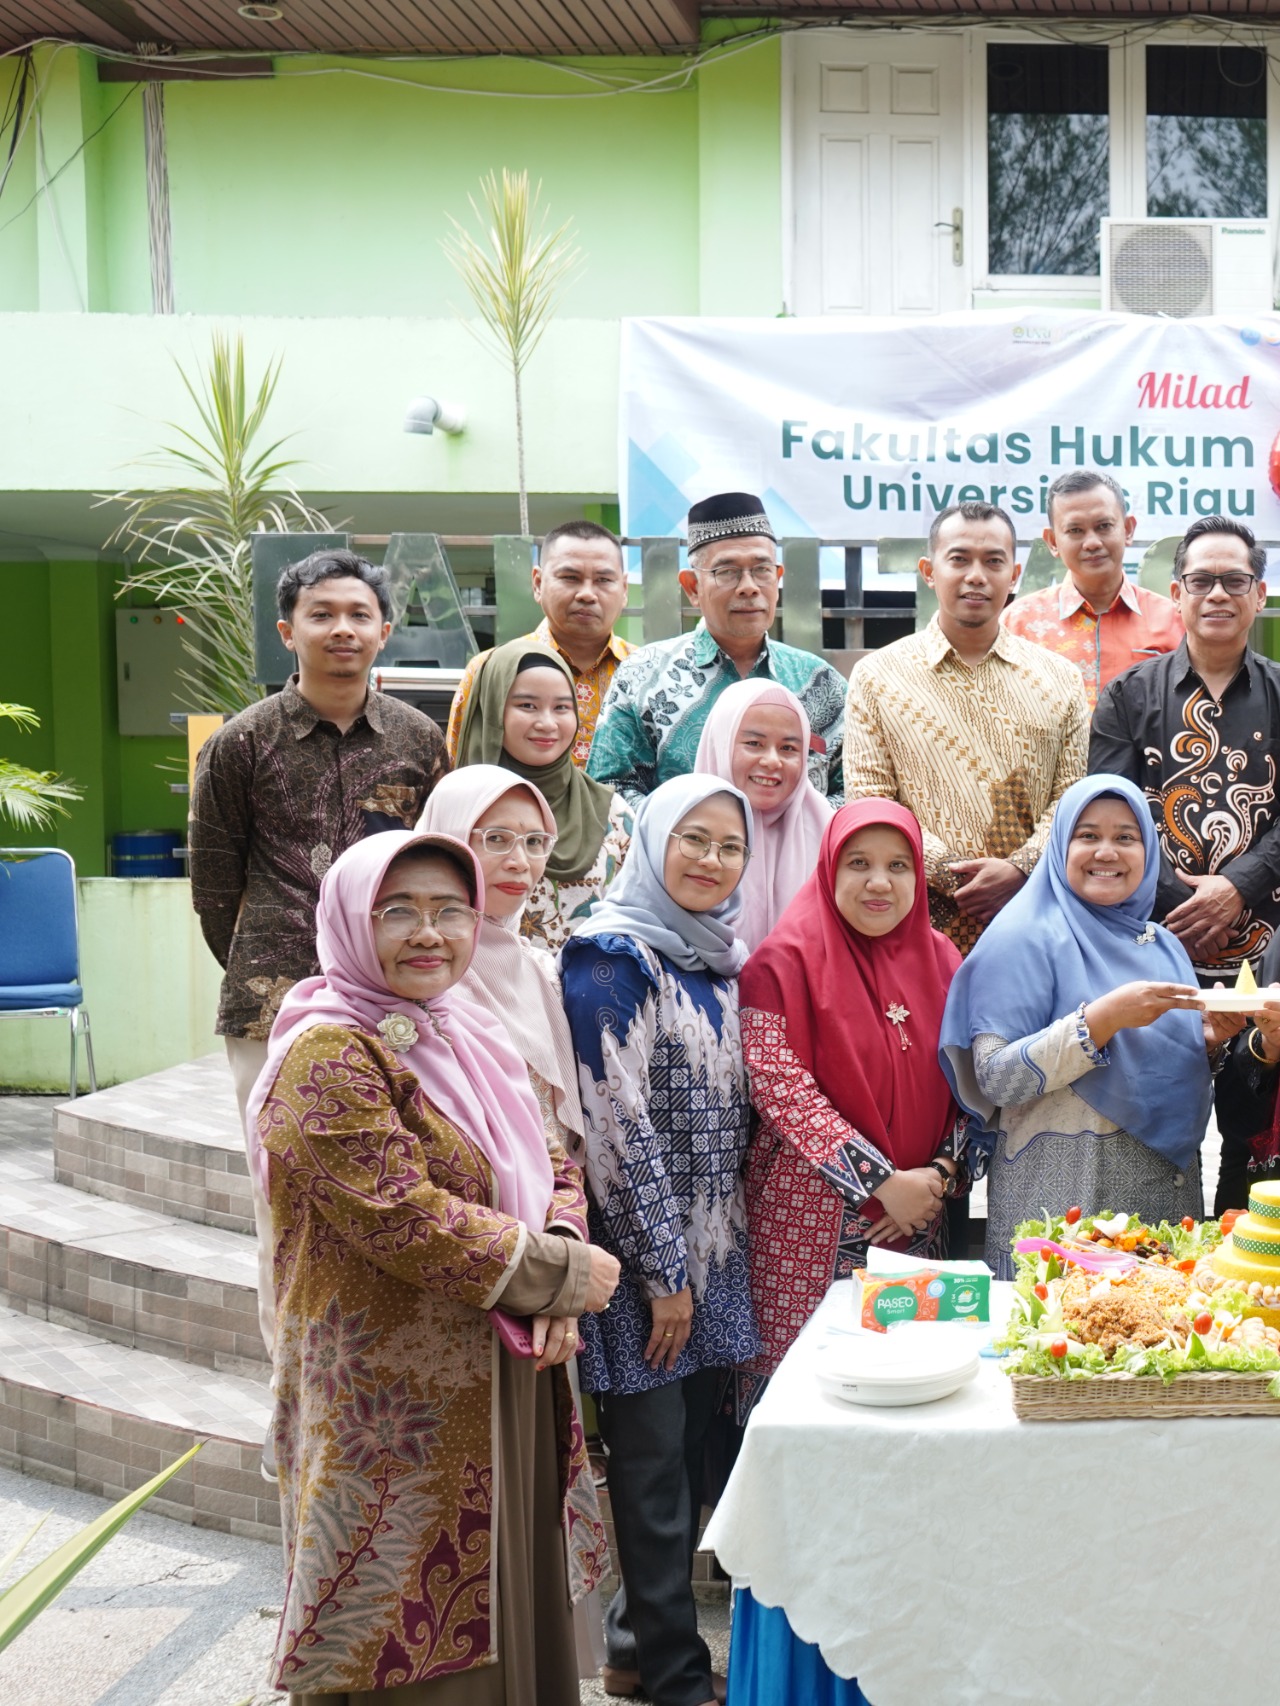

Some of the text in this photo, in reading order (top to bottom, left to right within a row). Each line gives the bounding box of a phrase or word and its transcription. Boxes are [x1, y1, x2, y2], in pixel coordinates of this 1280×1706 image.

[1137, 371, 1253, 409] Milad
[782, 419, 1254, 468] Fakultas Hukum
[843, 472, 1255, 516] Universi Riau
[877, 1296, 914, 1309] PASEO
